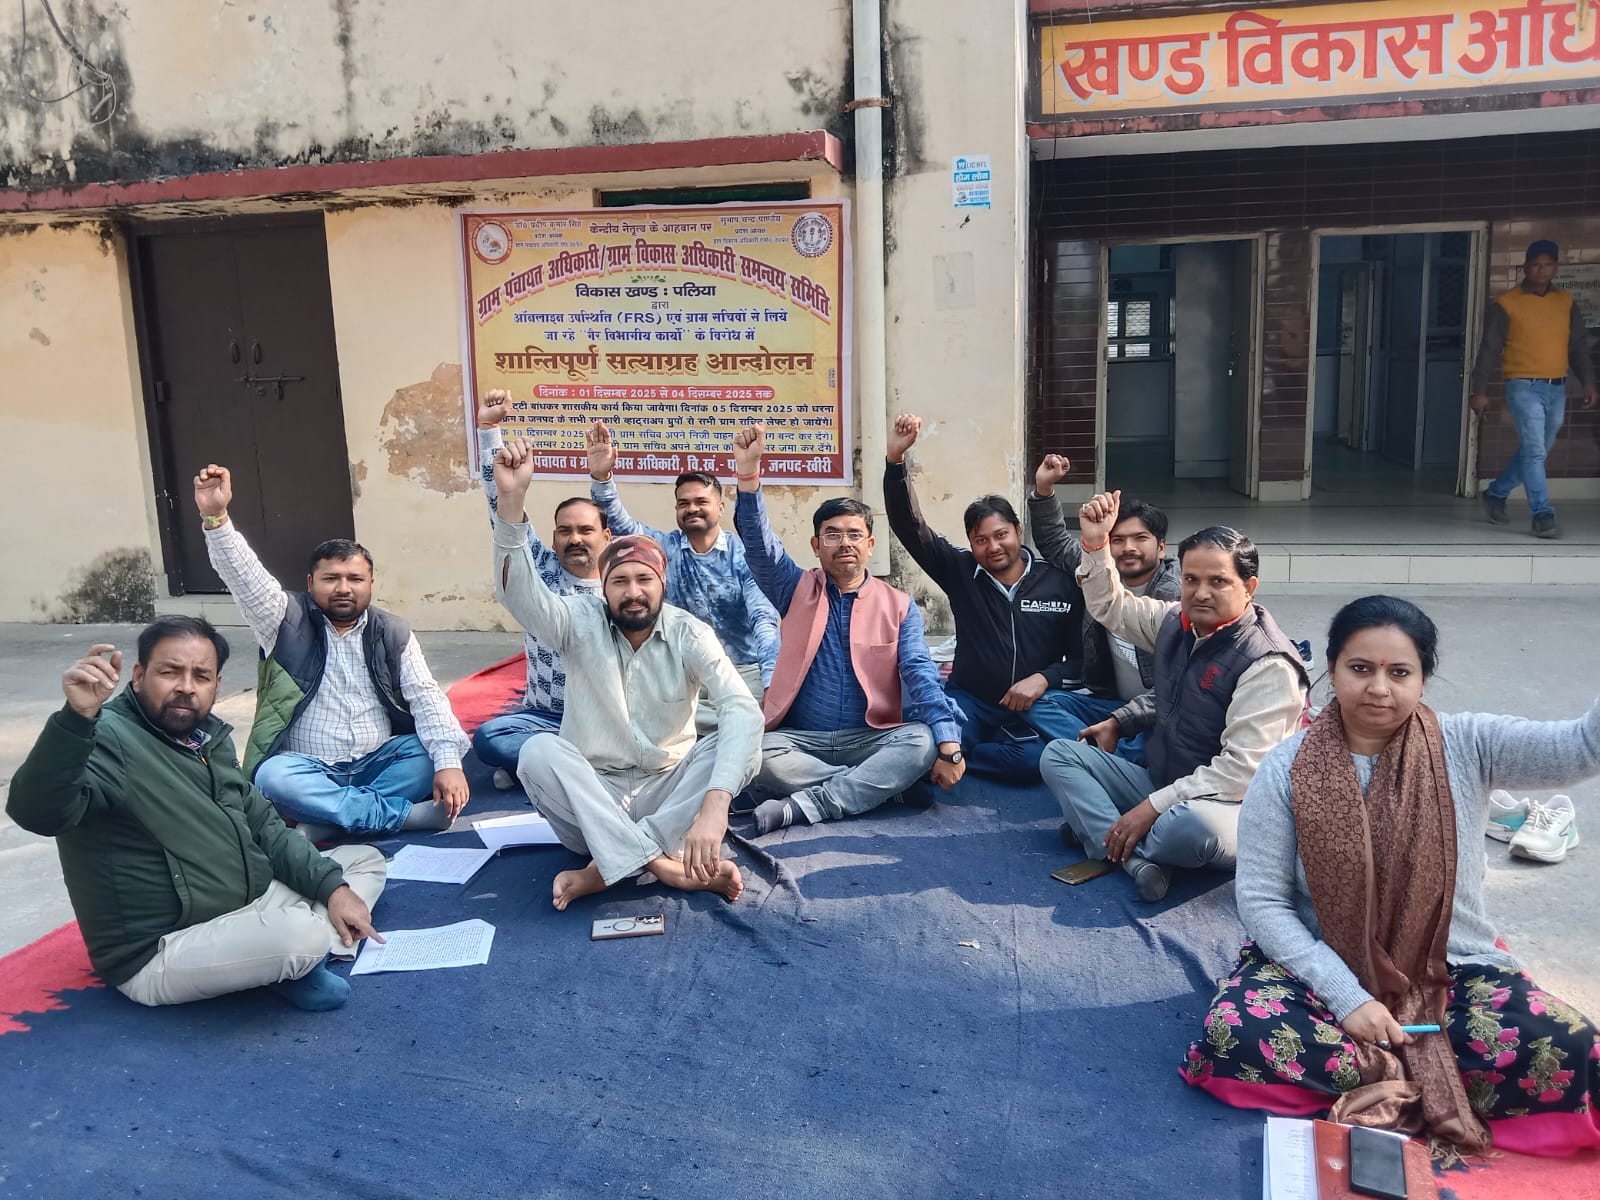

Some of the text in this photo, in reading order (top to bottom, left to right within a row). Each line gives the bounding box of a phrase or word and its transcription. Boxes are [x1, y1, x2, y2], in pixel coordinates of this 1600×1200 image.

[1059, 33, 1205, 100] खण्ड
[1218, 11, 1454, 88] विकास
[622, 222, 646, 237] नेतृत्व
[649, 221, 659, 233] के
[700, 223, 712, 233] पर
[477, 287, 502, 321] ग्राम
[504, 271, 545, 300] पंचायत
[635, 239, 677, 267] विकास
[681, 240, 736, 275] अधिकारी
[740, 255, 787, 293] समन्वय
[789, 275, 831, 318] समिति
[575, 283, 622, 298] विकास
[625, 286, 659, 298] खण्ड
[672, 282, 717, 298] पलिया
[651, 301, 670, 310] द्वारा
[568, 309, 612, 323] उपस्थिति
[617, 311, 662, 325] (FRS)
[666, 308, 683, 325] एवं
[686, 312, 709, 324] ग्राम
[712, 308, 748, 323] सचिवों
[751, 308, 761, 322] से
[764, 308, 788, 322] लिये
[544, 330, 558, 341] जा
[562, 327, 576, 342] रहे
[605, 327, 652, 341] विभागीय
[694, 327, 706, 341] के
[710, 327, 741, 341] विरोध
[745, 326, 756, 341] में
[494, 344, 815, 380] शान्तिपूर्ण सत्याग्रह आन्दोलन
[538, 384, 569, 397] दिनांक
[579, 388, 591, 397] 01
[594, 385, 628, 398] दिसम्बर
[630, 388, 657, 398] 2025
[659, 386, 669, 399] से
[671, 390, 685, 399] 04
[688, 386, 723, 400] दिसम्बर
[725, 389, 752, 399] 2025
[755, 389, 773, 399] तक
[511, 401, 528, 412] ट्टी
[622, 402, 643, 412] किया
[680, 402, 708, 413] दिनांक
[766, 405, 793, 413] 2025
[796, 403, 809, 413] को
[518, 415, 525, 423] व
[528, 415, 554, 424] जनपद
[719, 417, 736, 426] ग्राम
[560, 430, 584, 438] 2025
[560, 441, 585, 449] 2025
